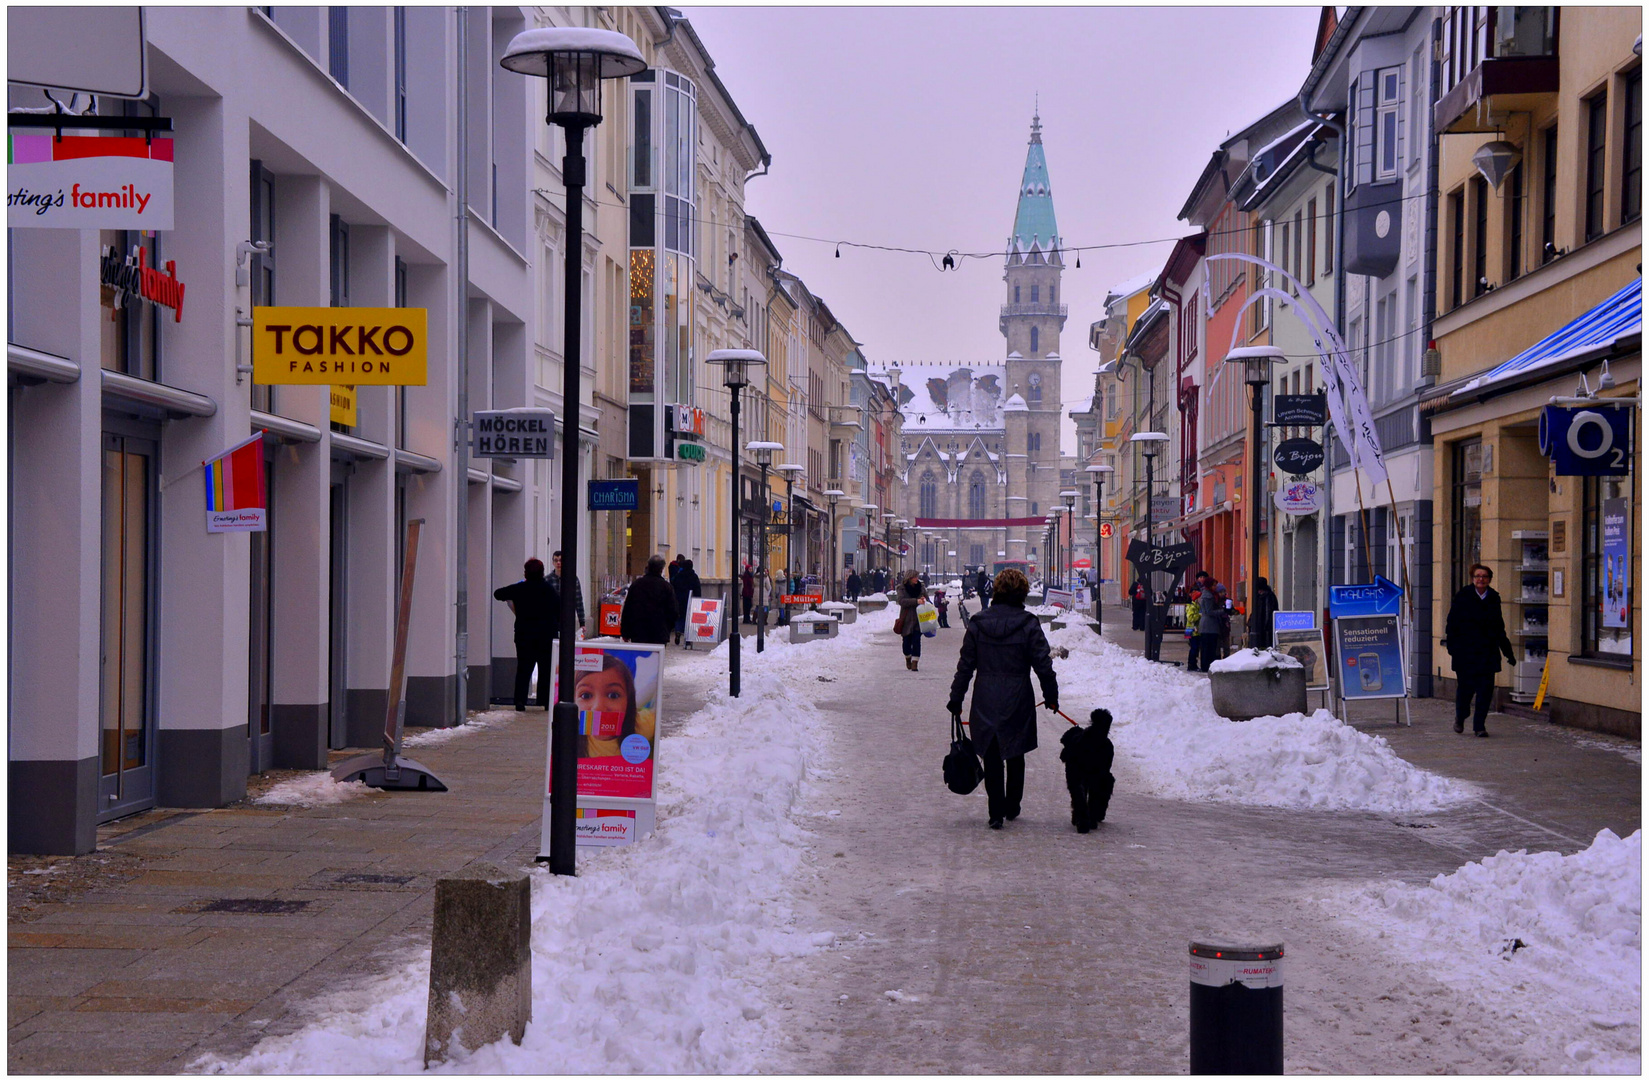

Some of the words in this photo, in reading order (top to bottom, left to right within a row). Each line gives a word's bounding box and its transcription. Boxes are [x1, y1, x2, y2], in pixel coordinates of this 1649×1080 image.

[71, 183, 151, 214] family
[290, 361, 390, 373] FASHION
[480, 416, 547, 433] MÖCKEL
[480, 434, 547, 452] HÖREN
[1275, 452, 1285, 462] le
[1289, 450, 1324, 466] Bijou
[1343, 627, 1388, 636] Sensationell
[1344, 635, 1378, 643] reduziert
[601, 823, 627, 834] family
